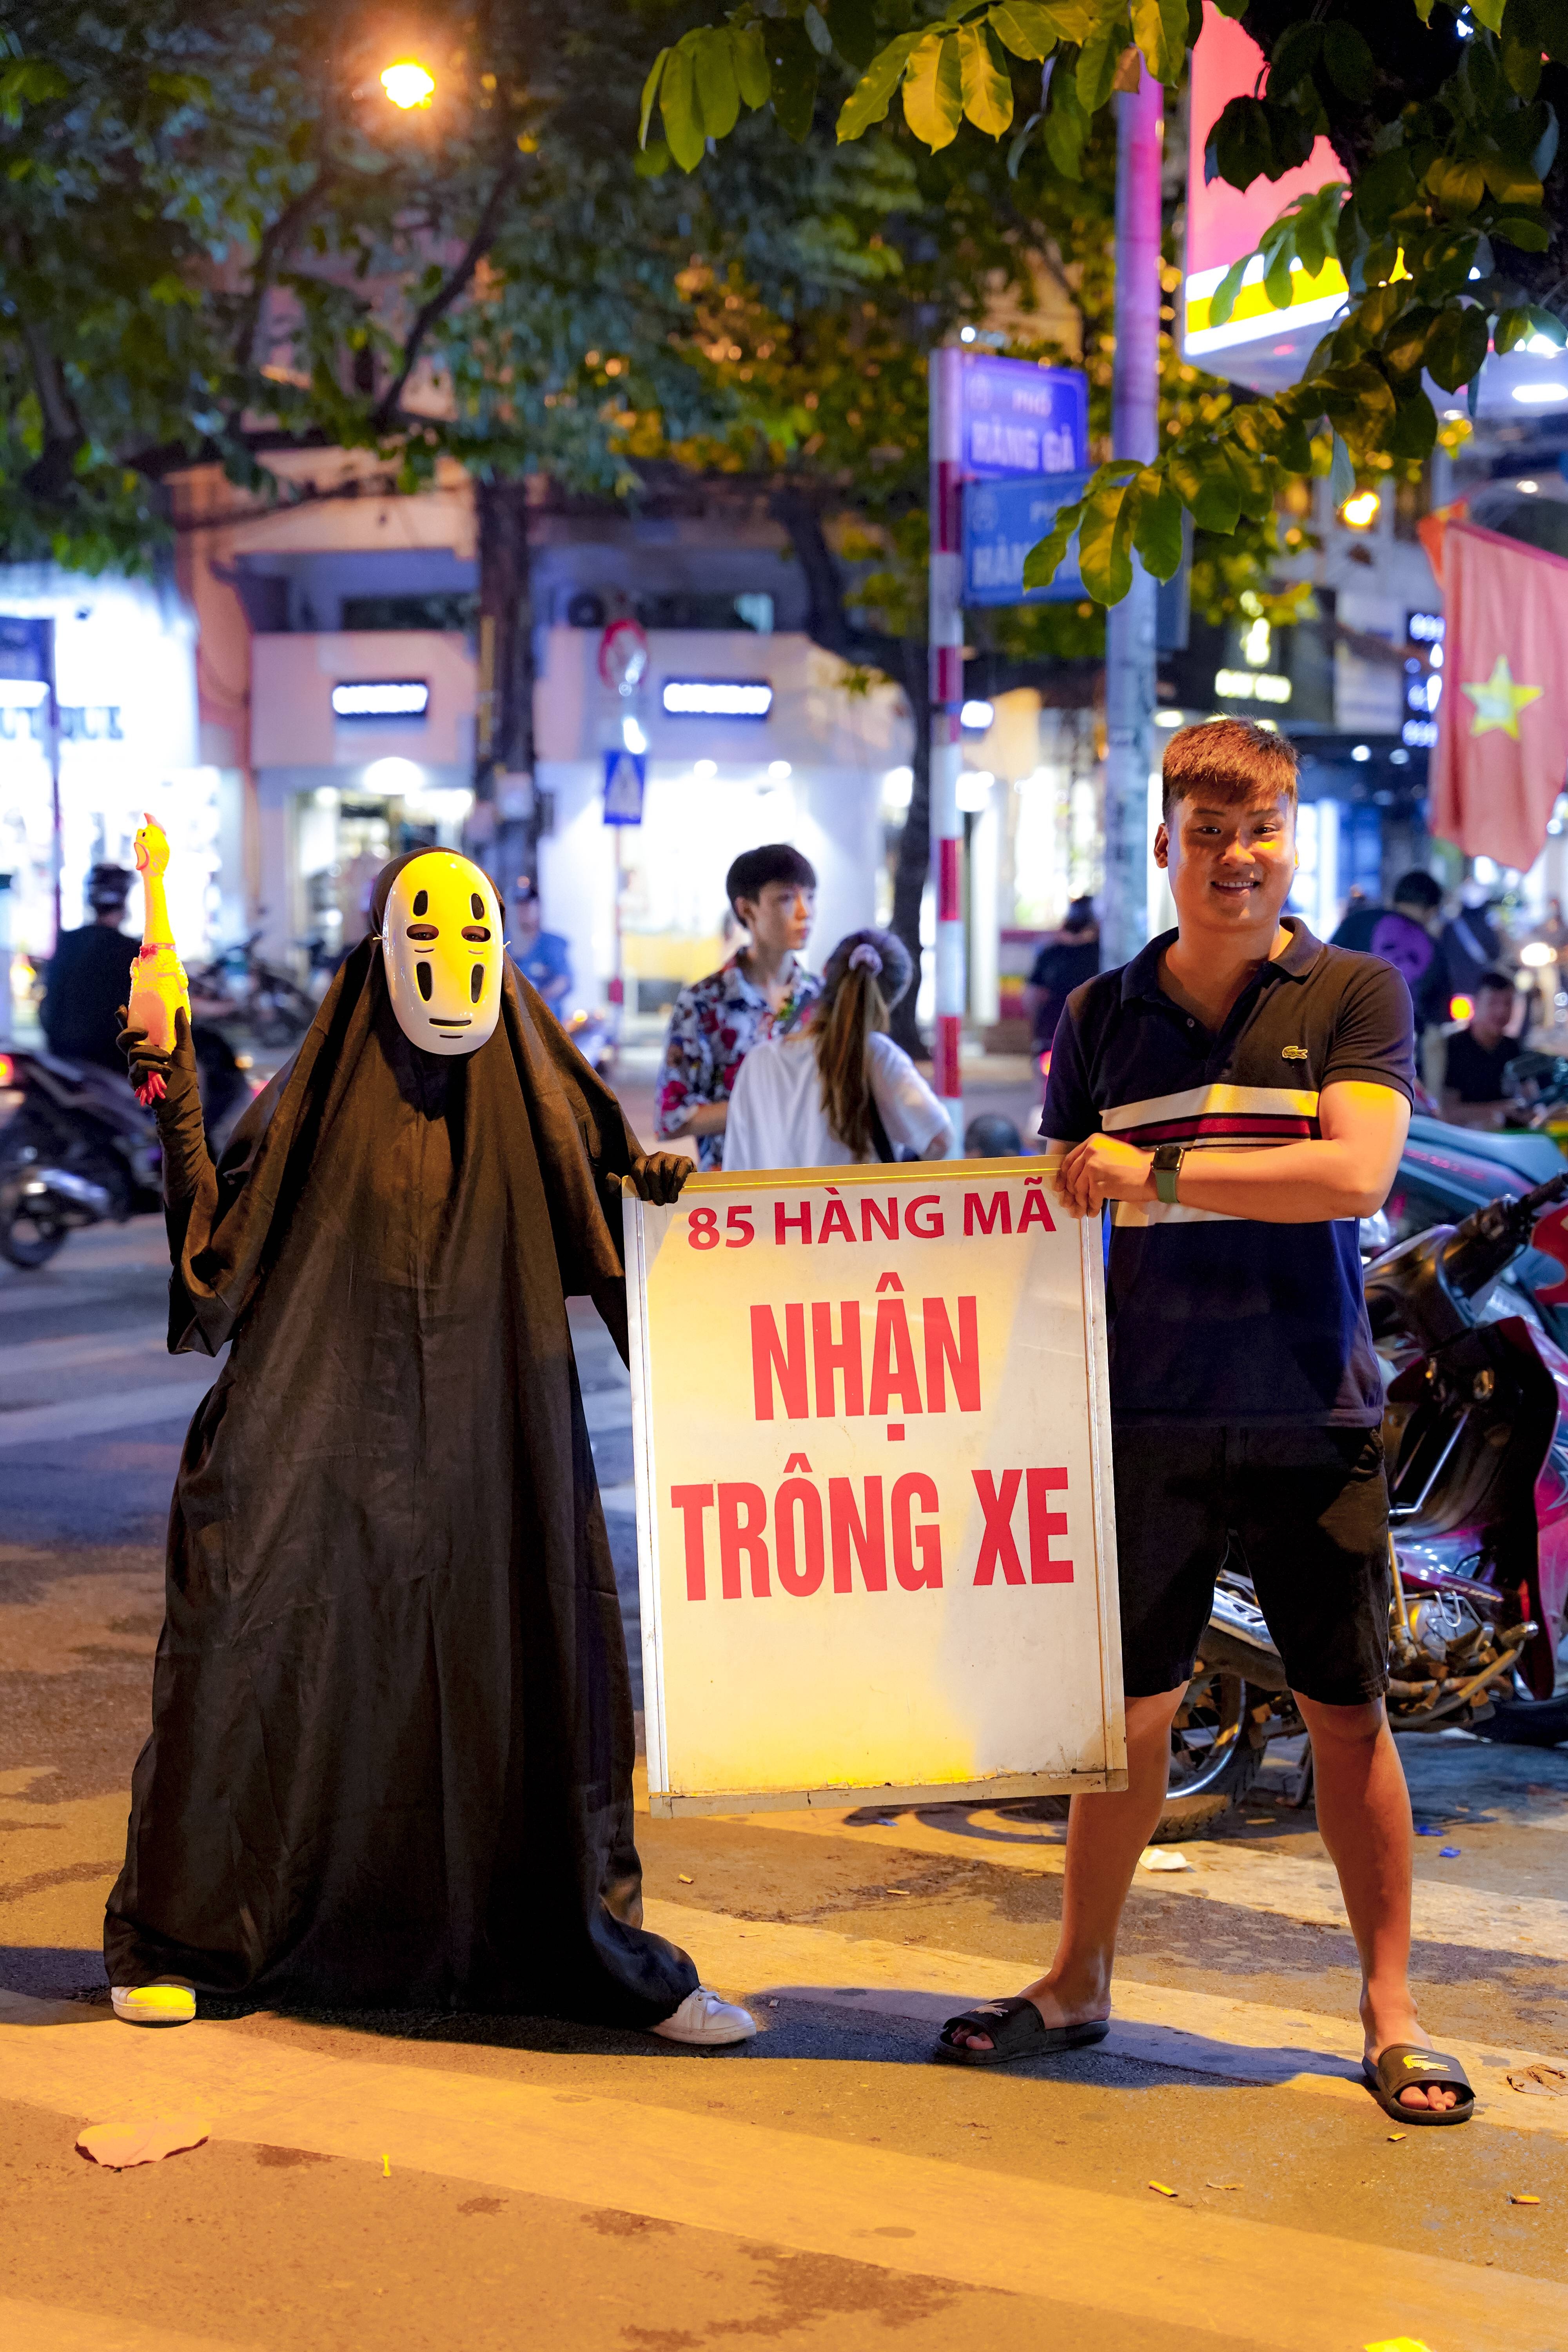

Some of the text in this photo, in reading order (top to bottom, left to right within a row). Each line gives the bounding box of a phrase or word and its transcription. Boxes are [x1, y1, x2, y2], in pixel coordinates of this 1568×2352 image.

[688, 1176, 1057, 1250] 85 HÀNG MÃ
[750, 1272, 981, 1442] NHẬN
[671, 1453, 1074, 1601] TRÔNG XE
